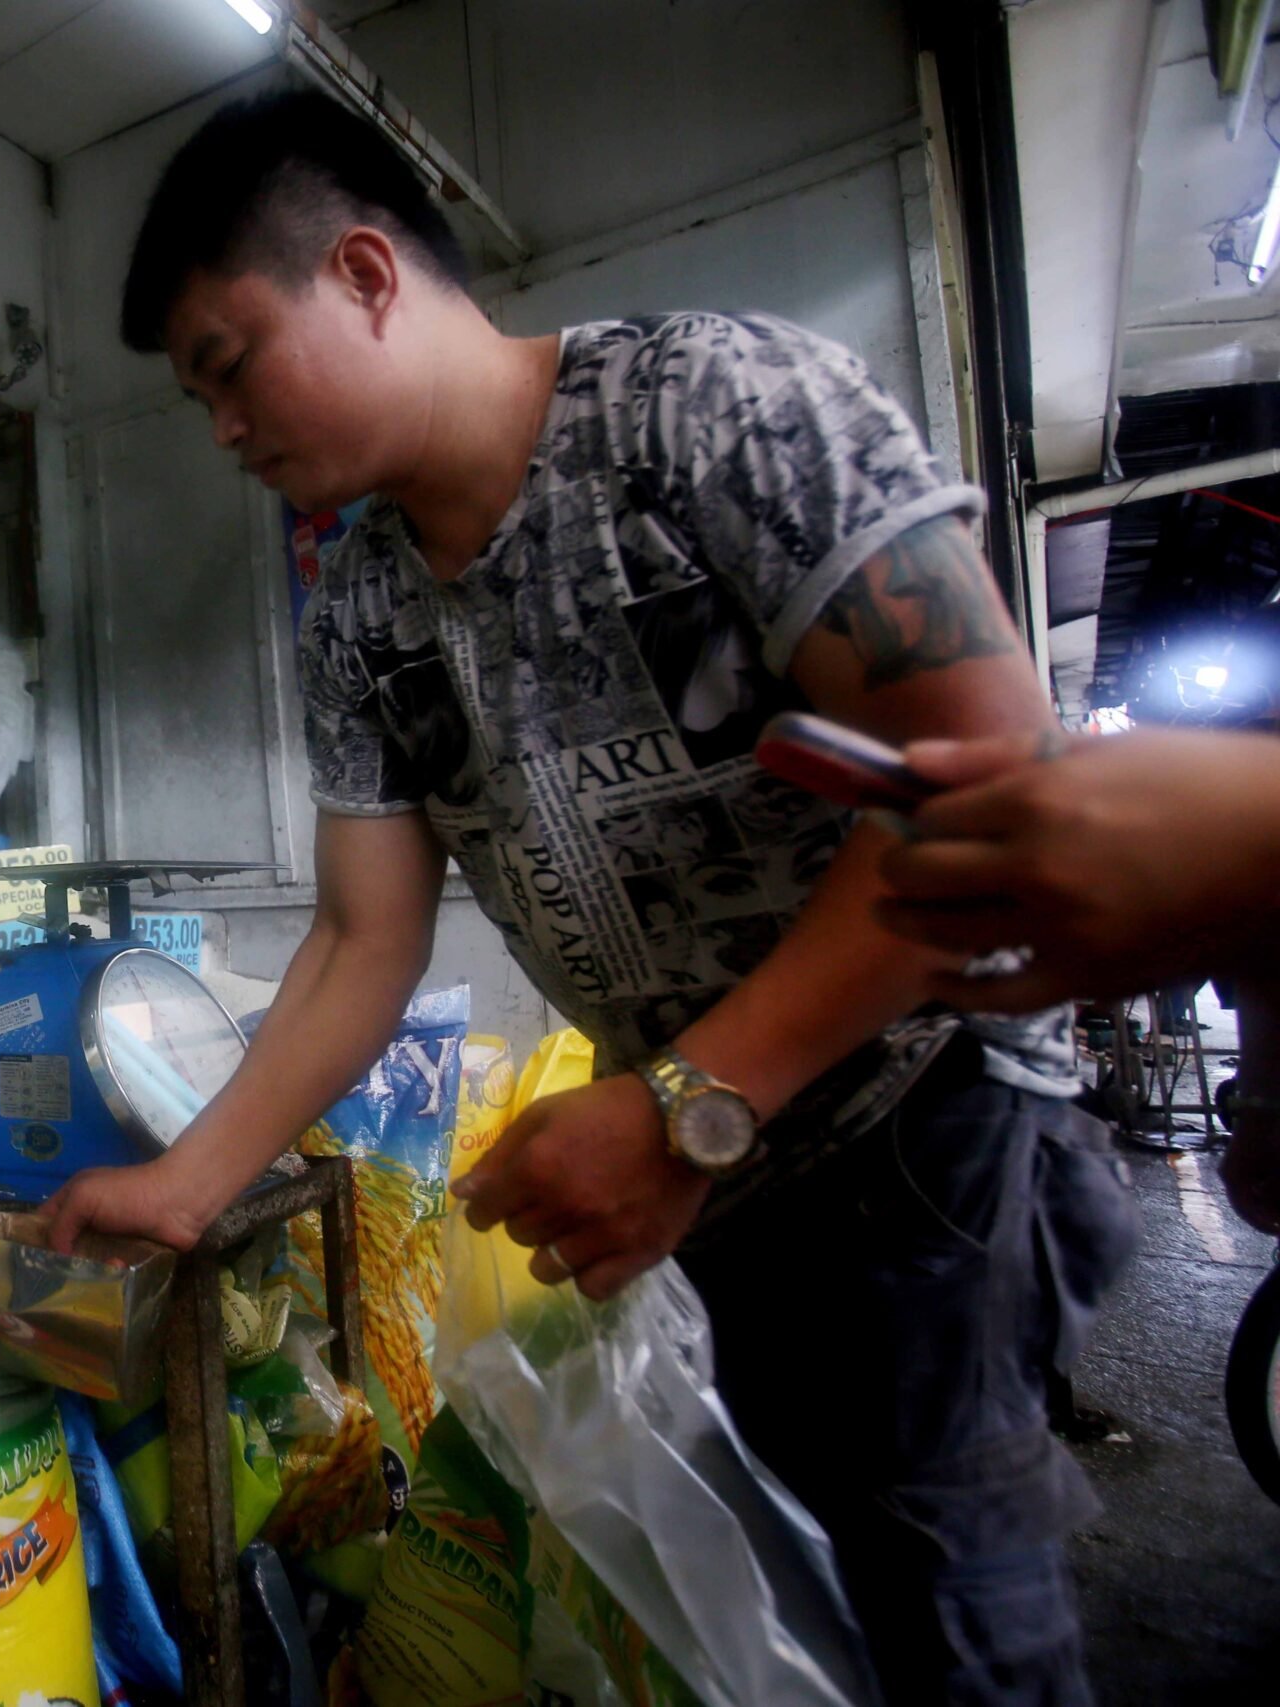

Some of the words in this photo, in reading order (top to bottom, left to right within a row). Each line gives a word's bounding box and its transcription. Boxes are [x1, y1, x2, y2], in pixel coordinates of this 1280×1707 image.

[574, 728, 679, 794] ART
[521, 842, 573, 919] POP
[551, 924, 612, 1000] ART
